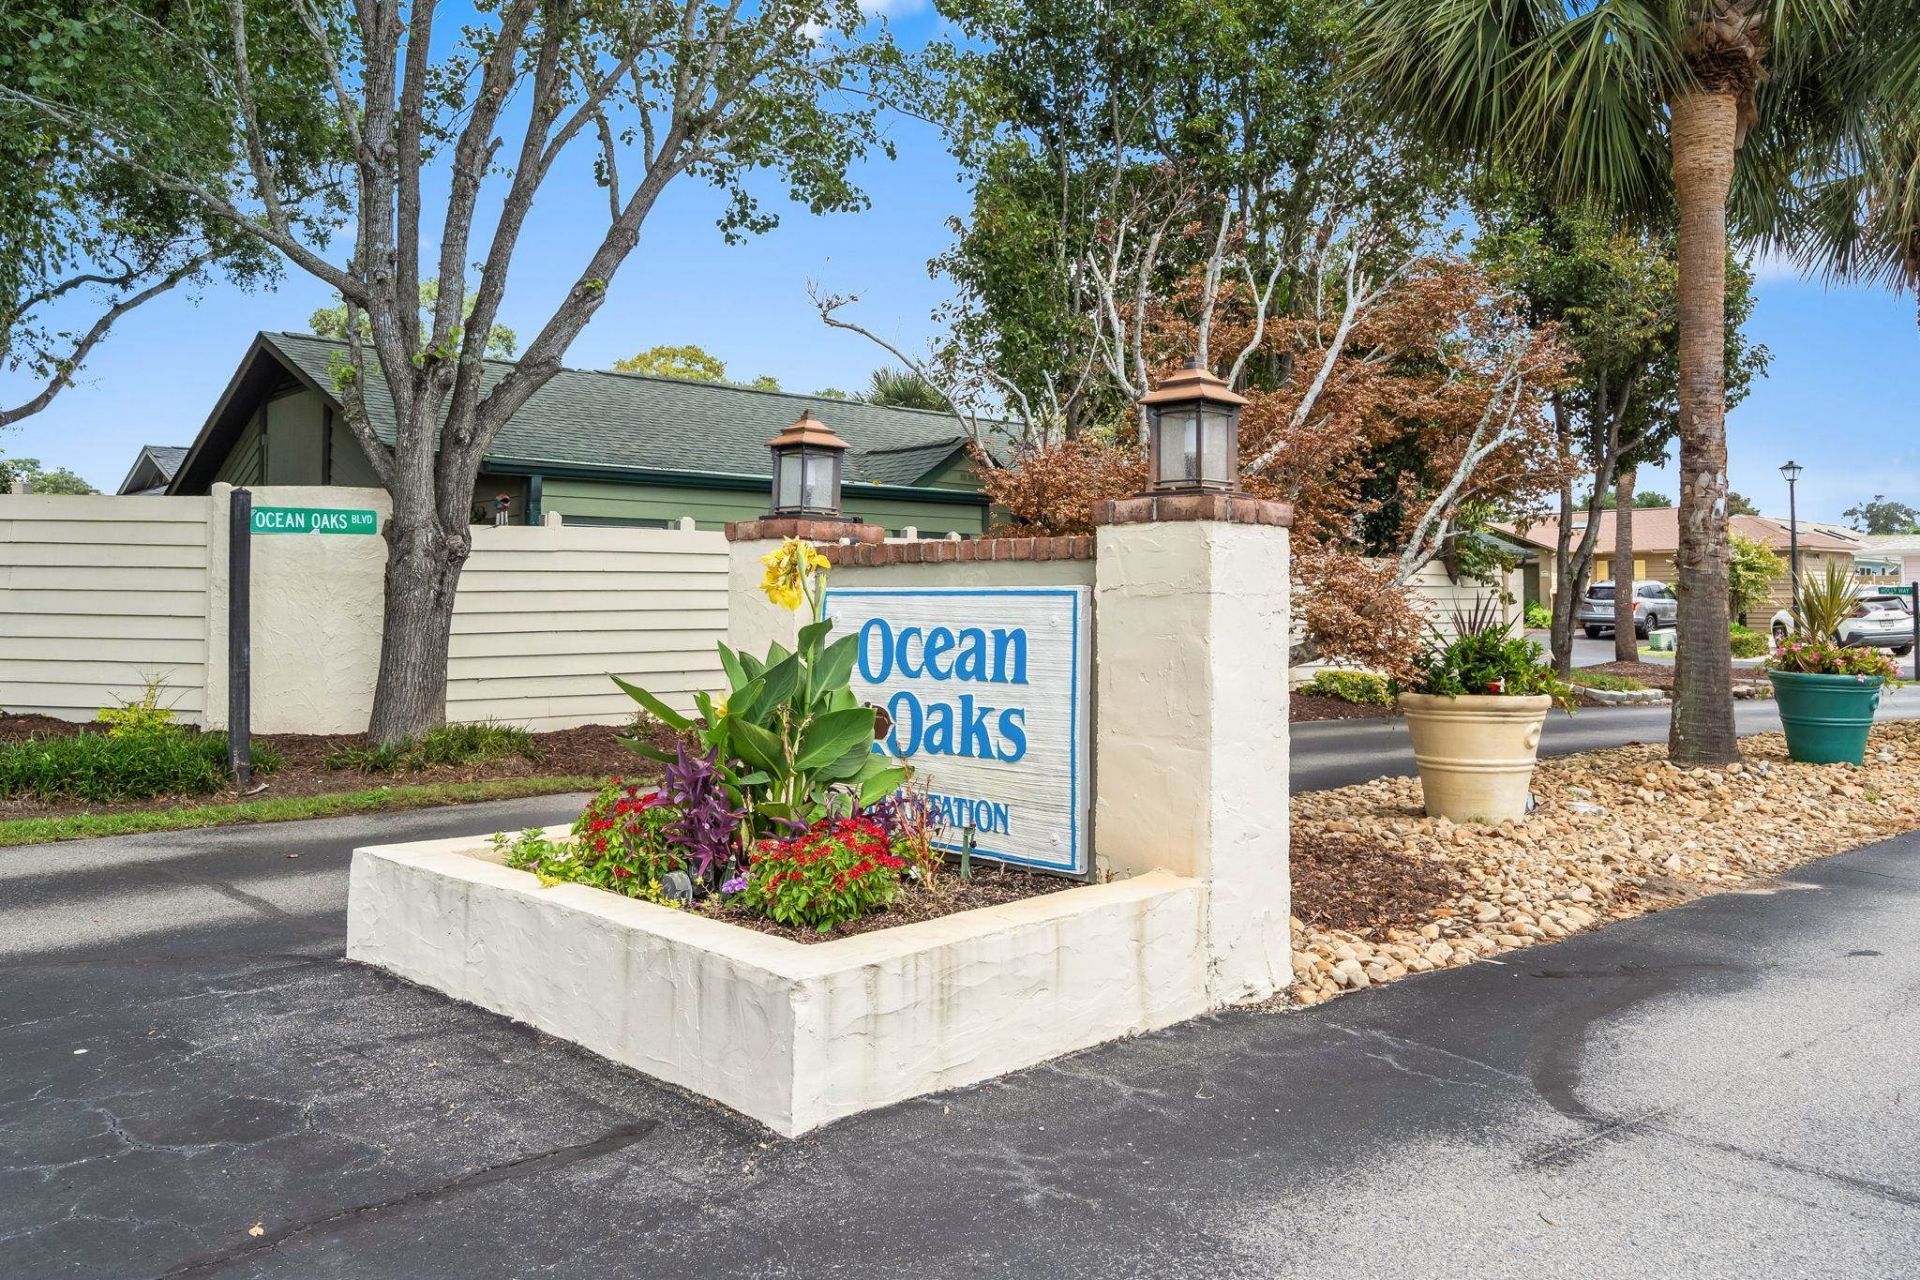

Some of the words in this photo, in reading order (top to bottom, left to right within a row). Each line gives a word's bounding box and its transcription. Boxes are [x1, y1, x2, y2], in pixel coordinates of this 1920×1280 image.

[255, 512, 304, 528] OCEAN
[311, 513, 347, 529] OAKS
[351, 514, 373, 524] BLVD
[858, 617, 1029, 684] Ocean
[887, 691, 1027, 763] Oaks
